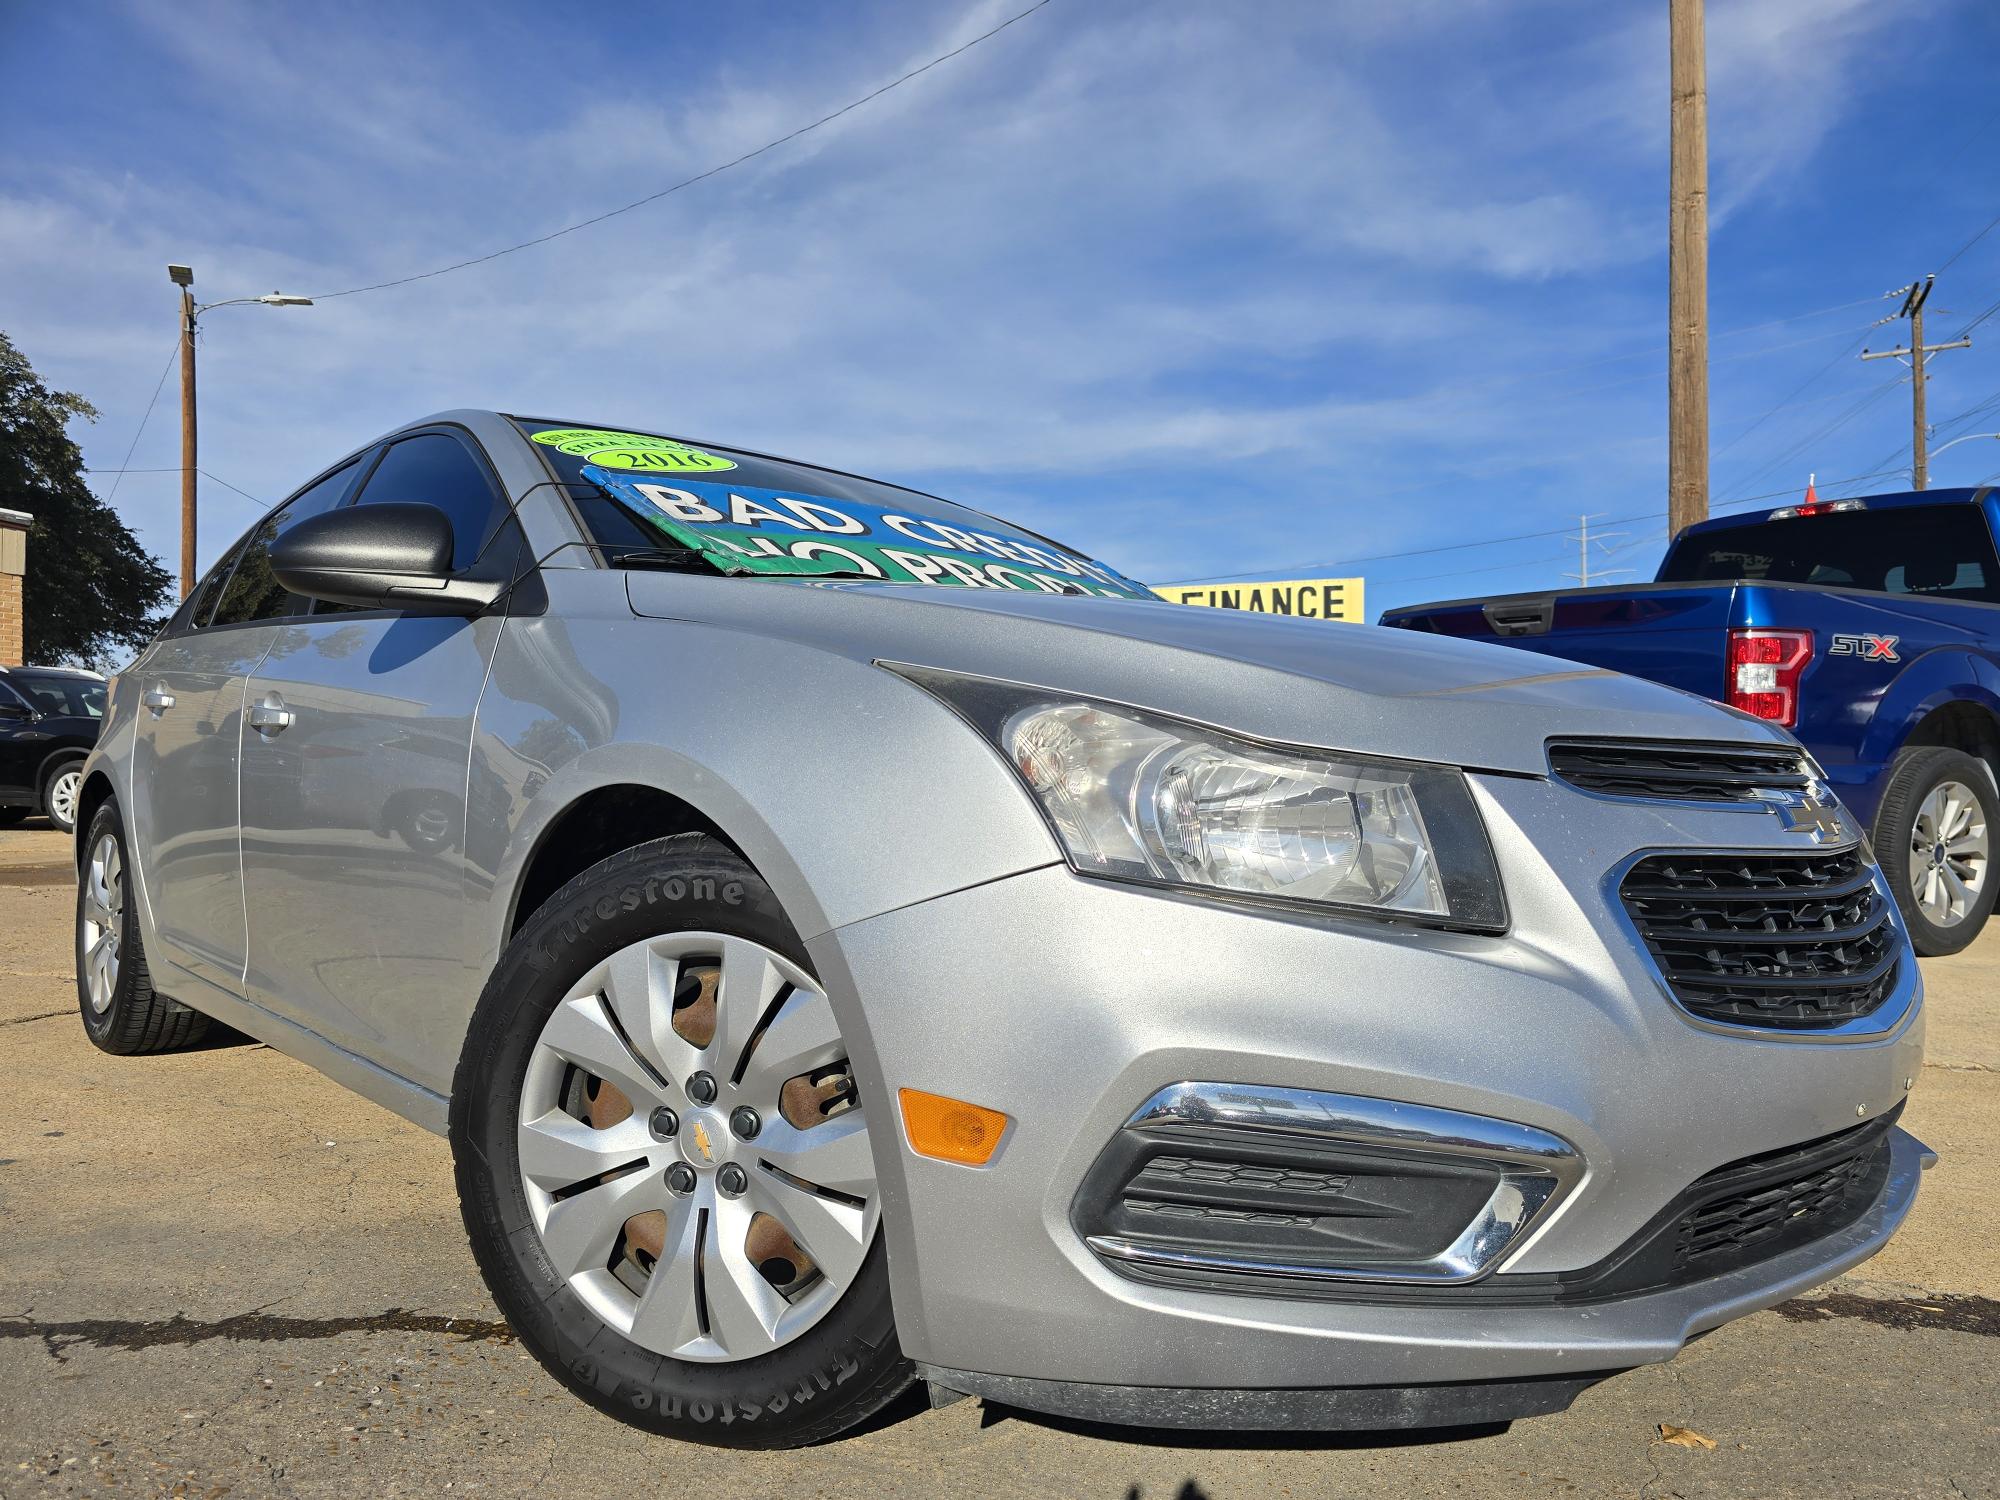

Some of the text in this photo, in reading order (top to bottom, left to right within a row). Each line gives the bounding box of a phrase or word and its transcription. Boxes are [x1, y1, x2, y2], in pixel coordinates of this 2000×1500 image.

[616, 452, 713, 468] 2016
[631, 482, 870, 536] BAD
[1830, 633, 1900, 663] STX
[536, 872, 746, 963] Firestone
[627, 1350, 863, 1426] Firestone
